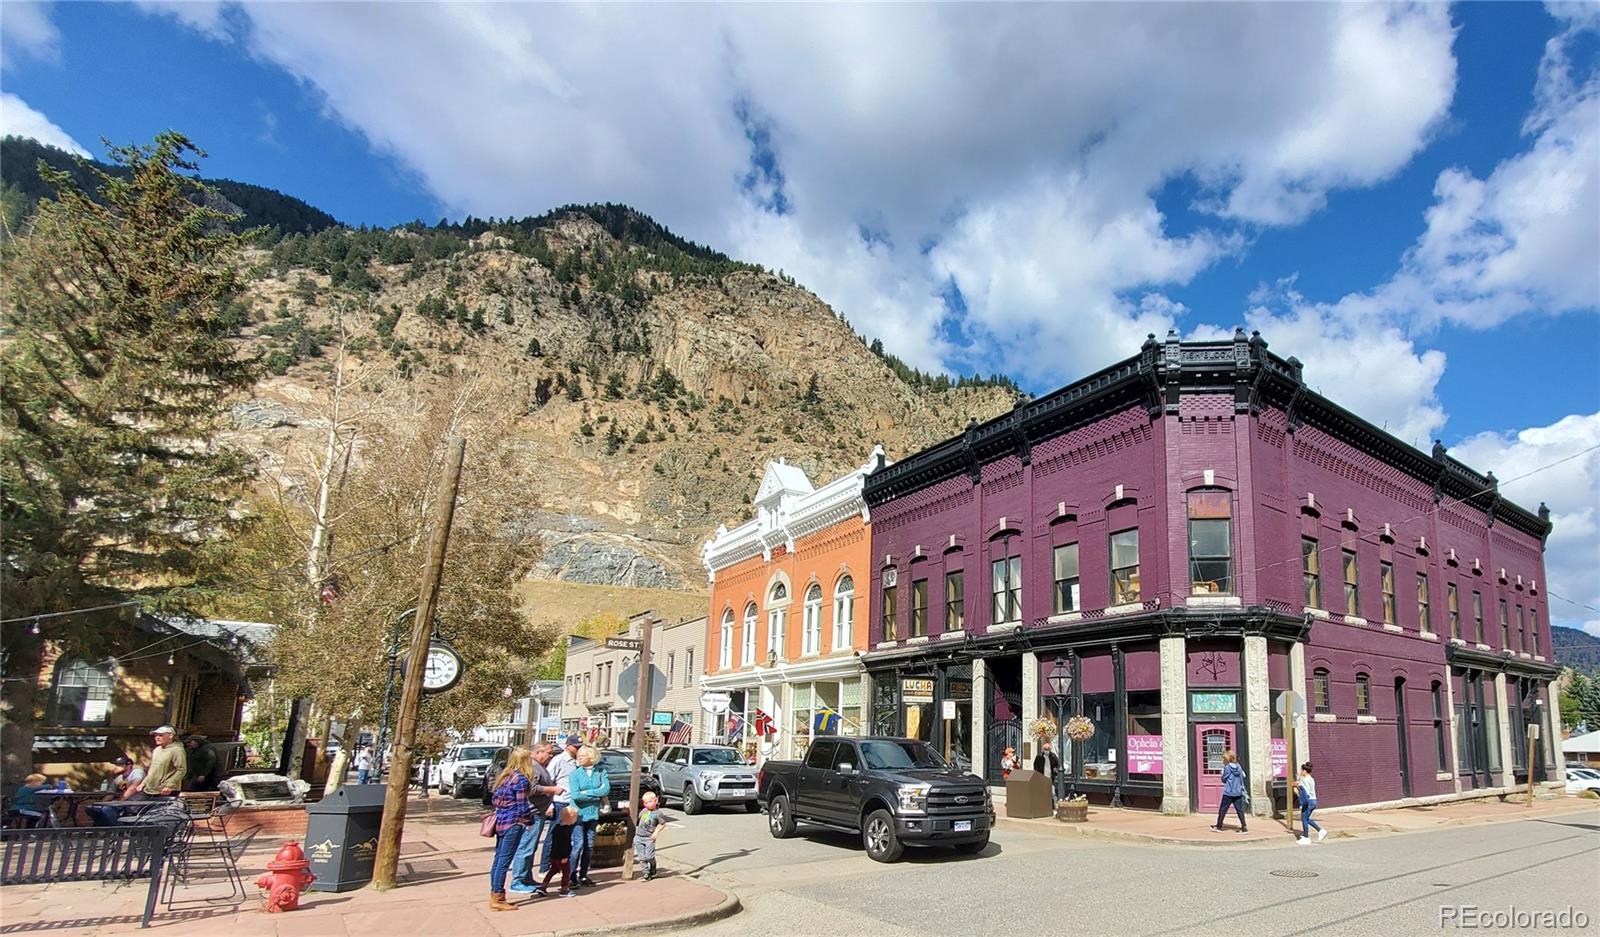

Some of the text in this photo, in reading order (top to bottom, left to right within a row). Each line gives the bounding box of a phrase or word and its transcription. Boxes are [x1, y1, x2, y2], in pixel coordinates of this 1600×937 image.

[608, 640, 639, 649] ROSE ST
[905, 680, 932, 689] LUCHA
